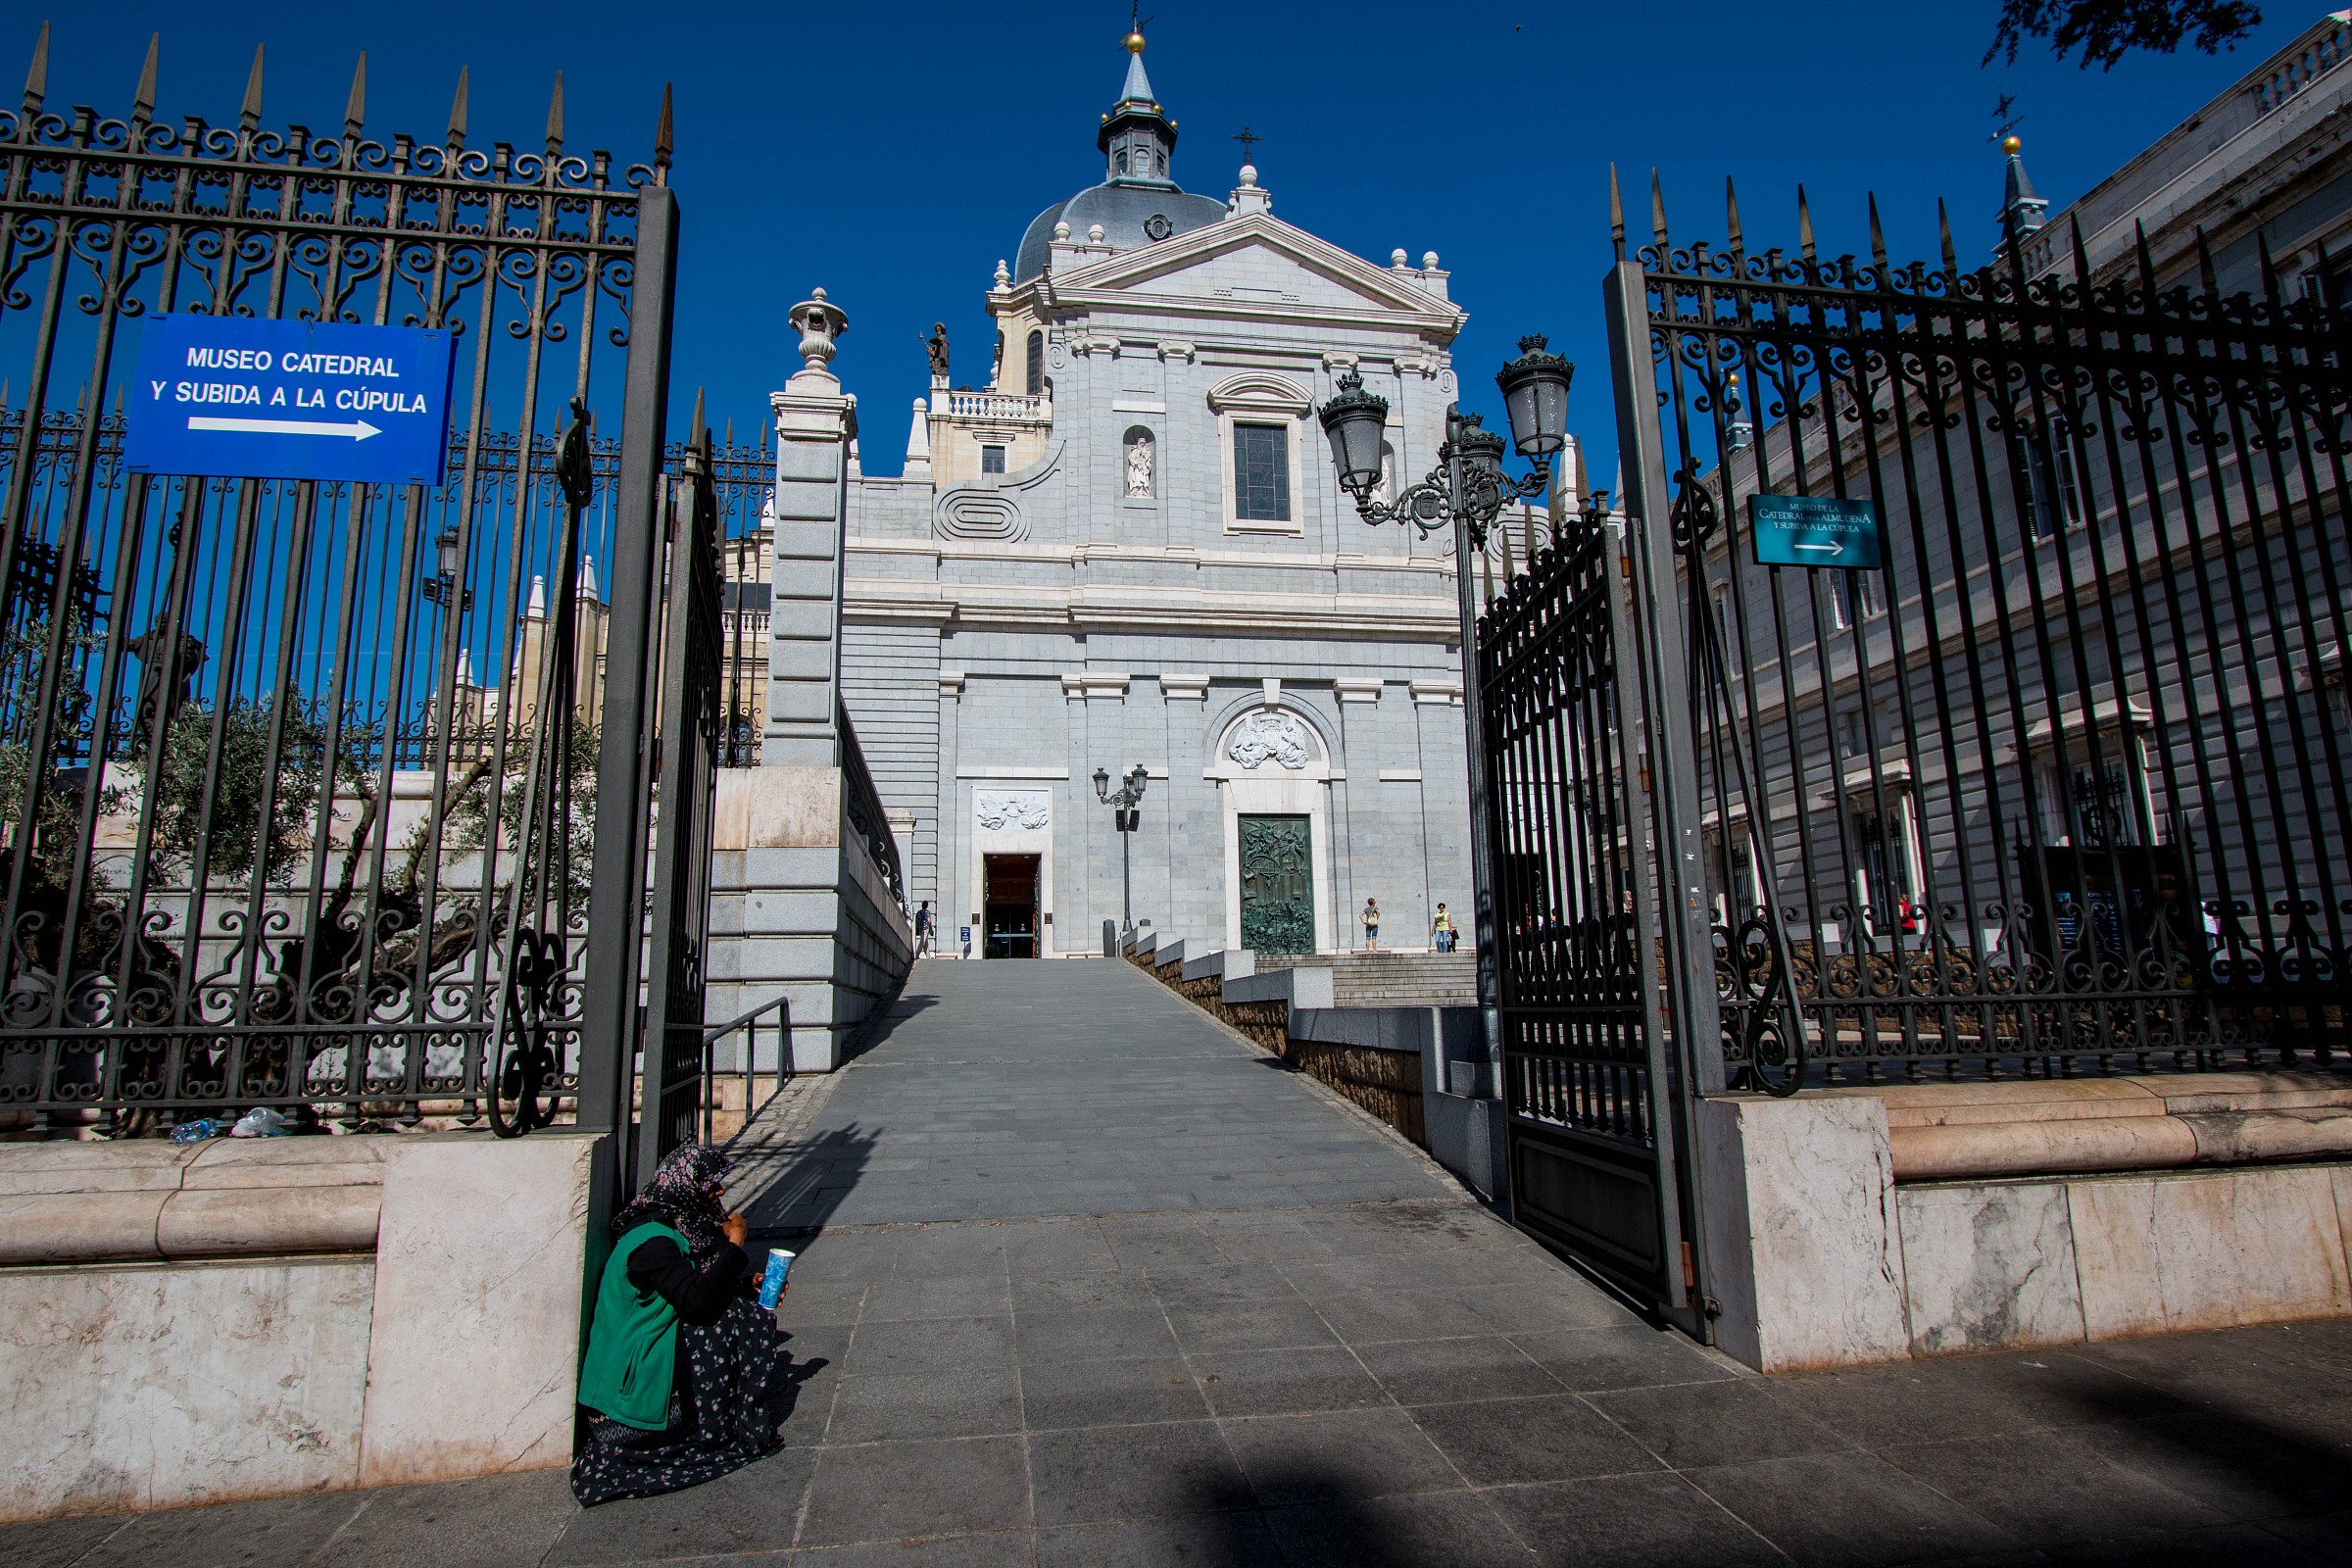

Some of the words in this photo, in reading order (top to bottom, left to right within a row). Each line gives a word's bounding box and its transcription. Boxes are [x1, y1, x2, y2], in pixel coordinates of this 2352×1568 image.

[186, 347, 272, 370] MUSEO
[281, 352, 400, 377] CATEDRAL
[151, 380, 167, 401] Y
[174, 381, 261, 405] SUBIDA
[270, 386, 286, 406] A
[295, 388, 325, 408] LA
[335, 386, 427, 414] CÚPULA
[1789, 503, 1817, 512] MUSEO
[1758, 508, 1805, 520] CATEDRAL
[1821, 514, 1872, 523] ALMUDENA
[1780, 521, 1809, 530] SUBIDA
[1828, 522, 1860, 533] CÚPULA
